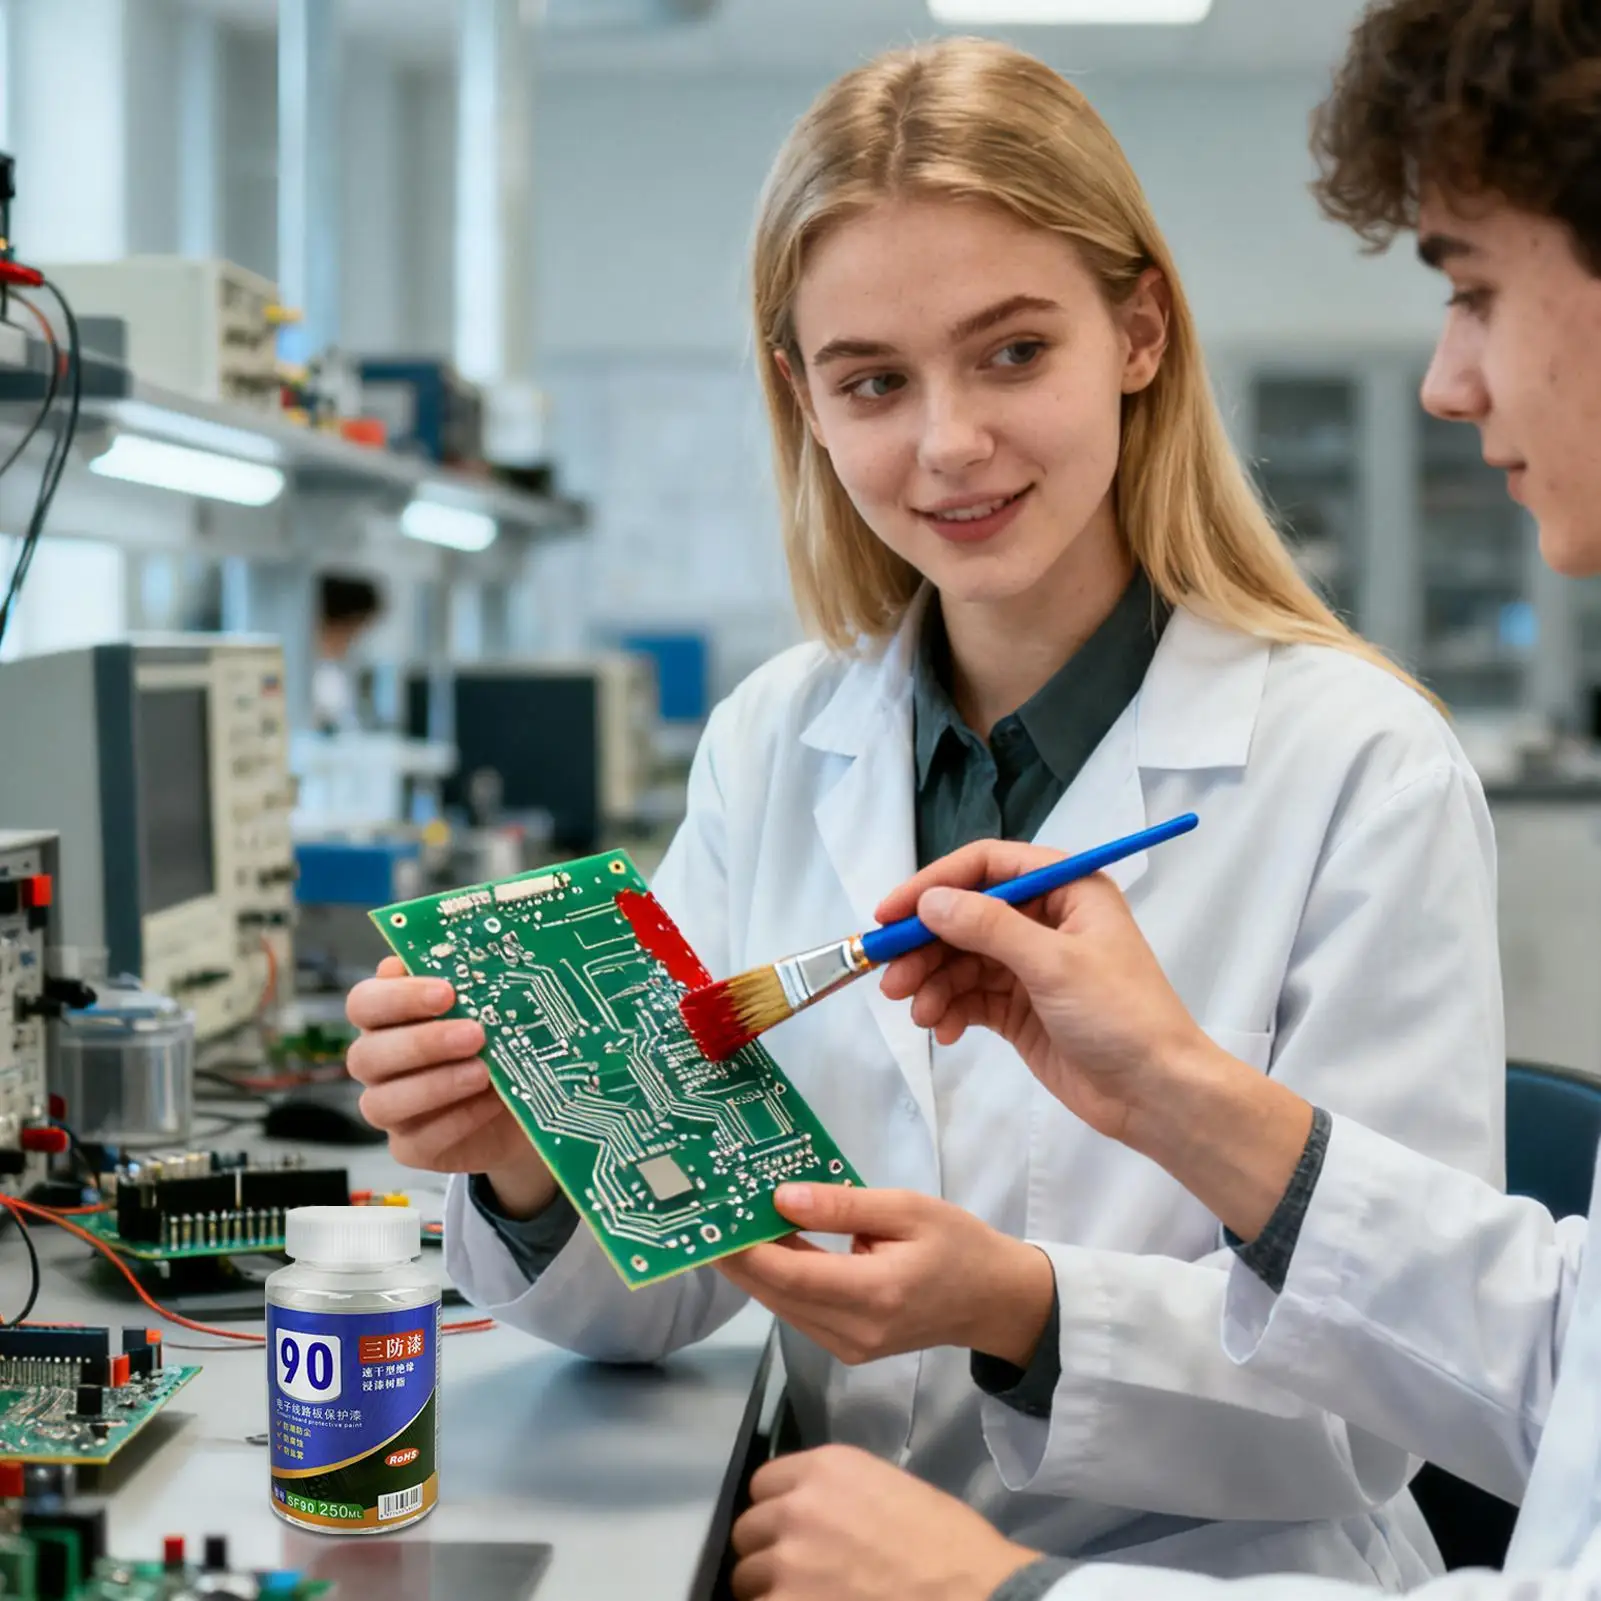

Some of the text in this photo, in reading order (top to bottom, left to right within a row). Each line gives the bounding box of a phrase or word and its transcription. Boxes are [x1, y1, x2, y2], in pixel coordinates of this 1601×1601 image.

[363, 1333, 422, 1359] 三防漆
[281, 1337, 333, 1391] 90
[389, 1449, 418, 1465] RoHS
[287, 1495, 315, 1514] SF90
[319, 1502, 363, 1519] 250ML
